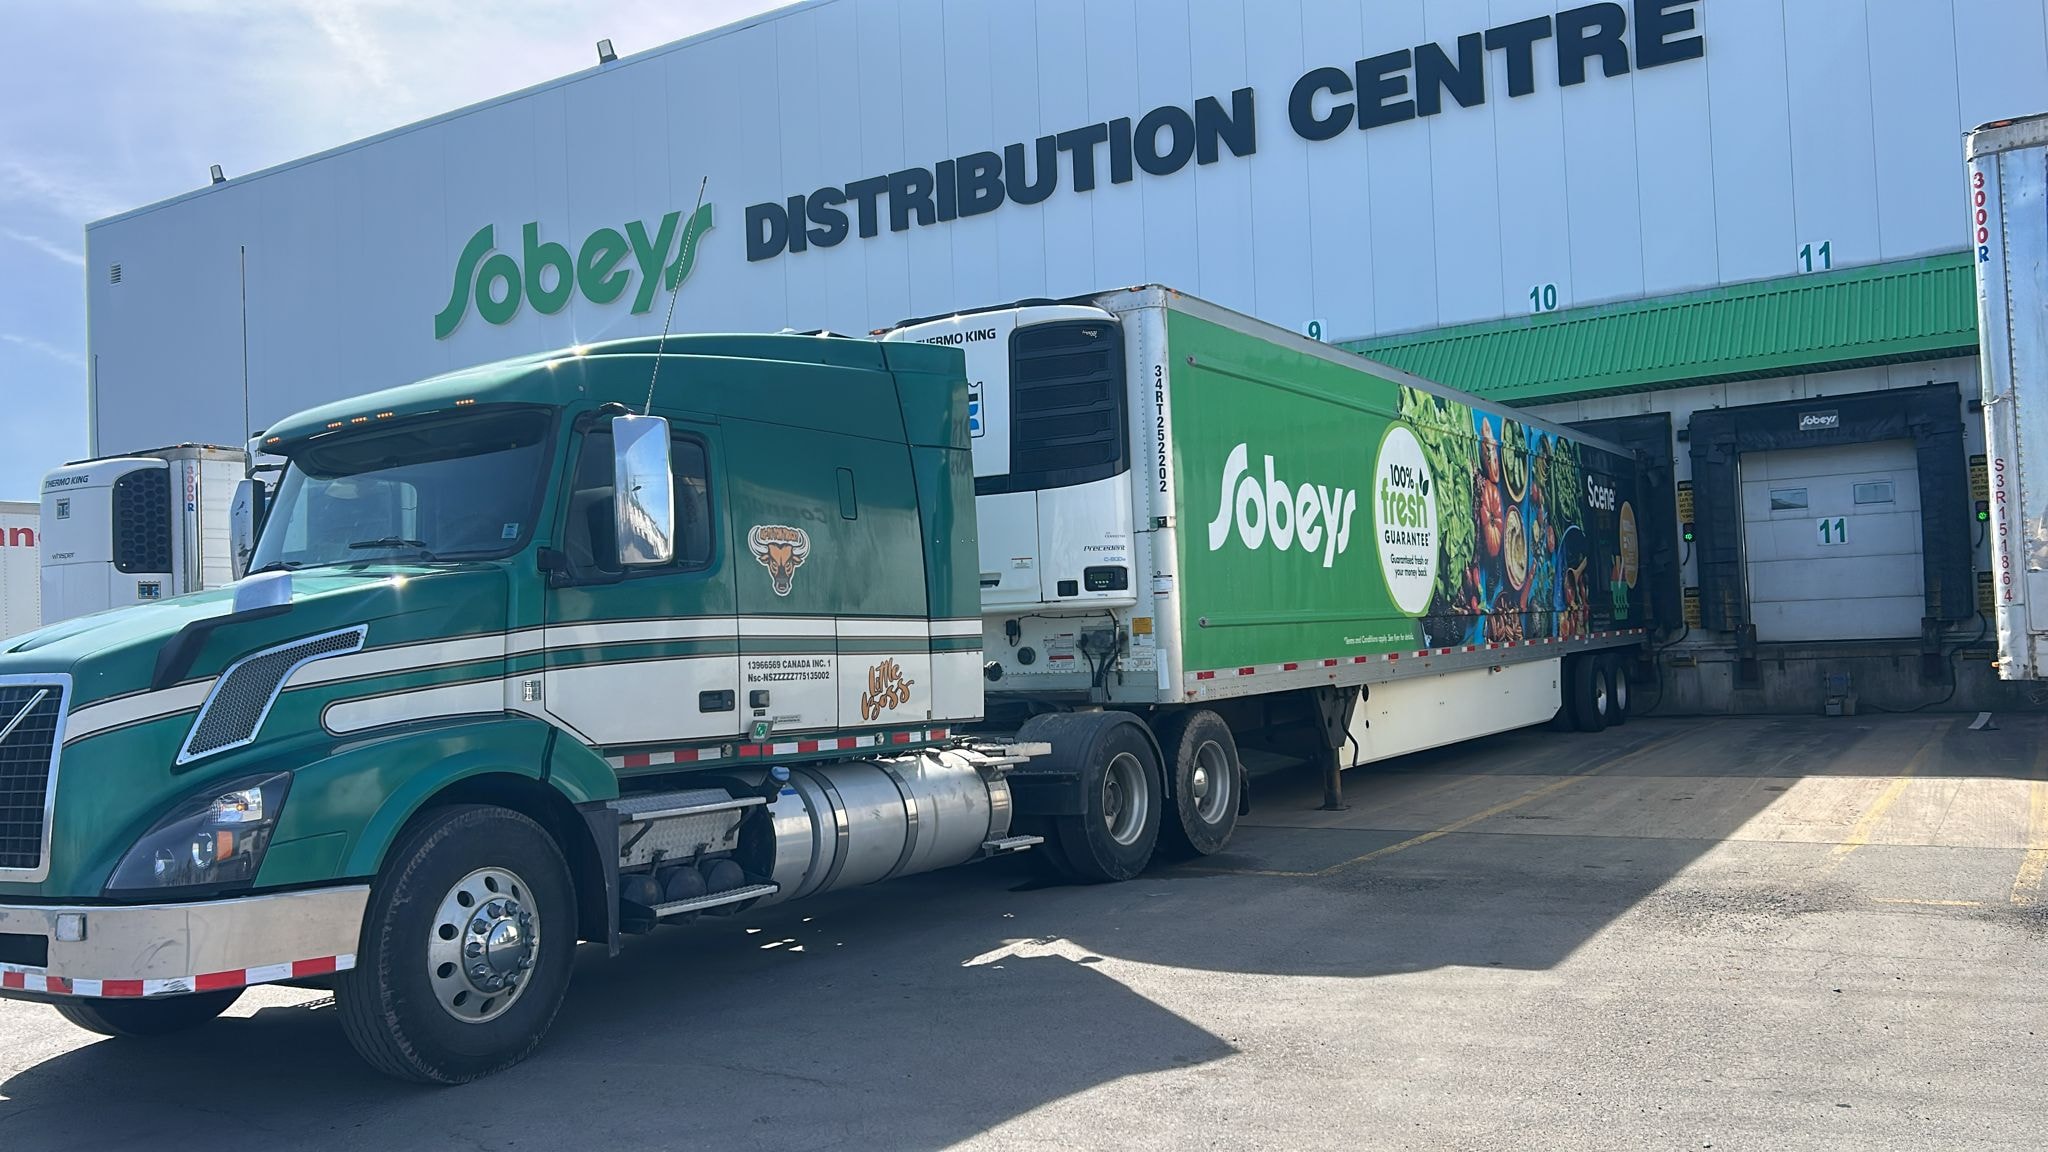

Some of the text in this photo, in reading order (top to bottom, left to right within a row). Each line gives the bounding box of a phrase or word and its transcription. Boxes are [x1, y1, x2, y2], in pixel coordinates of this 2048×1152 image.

[434, 0, 1704, 340] Sobeys DISTRIBUTION CENTRE
[1973, 172, 1989, 263] 3000R
[1800, 240, 1832, 272] 11
[1530, 284, 1557, 312] 10
[916, 328, 996, 346] ERMO KING
[1308, 321, 1321, 340] 9
[1154, 364, 1167, 492] 34RT252202
[1800, 415, 1837, 425] Sobeys
[45, 475, 89, 488] THERMO KING
[1390, 463, 1414, 489] 100%
[1208, 442, 1356, 568] Sobeys
[1381, 477, 1428, 528] fresh
[1819, 517, 1847, 544] 11
[1994, 458, 2012, 602] S3R151864
[748, 661, 781, 669] 13966569
[782, 660, 811, 668] CANADA
[812, 660, 826, 668] INC.
[869, 657, 902, 697] Little
[861, 678, 915, 720] Boss
